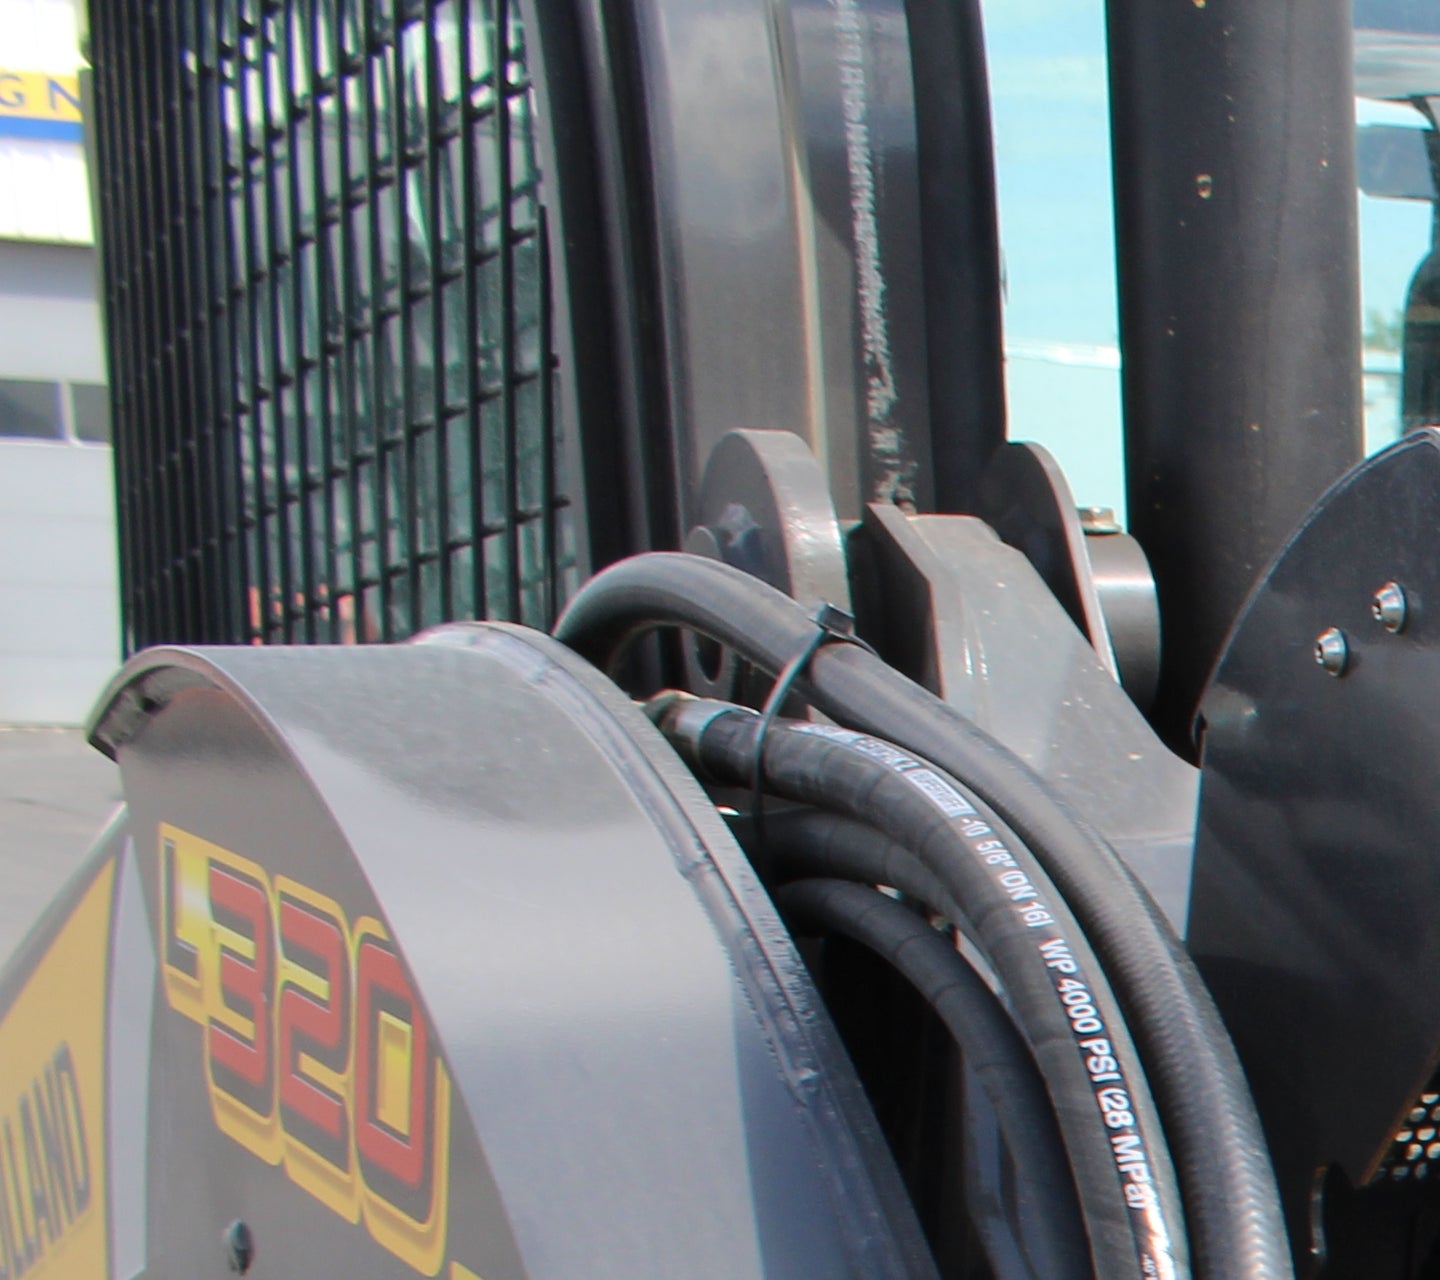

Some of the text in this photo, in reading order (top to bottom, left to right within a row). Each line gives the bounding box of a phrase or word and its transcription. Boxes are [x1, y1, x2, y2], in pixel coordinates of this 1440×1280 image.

[1038, 937, 1077, 974] WP
[1056, 977, 1103, 1034] 4000
[1079, 1037, 1122, 1083] PSI
[1097, 1087, 1136, 1129] (28
